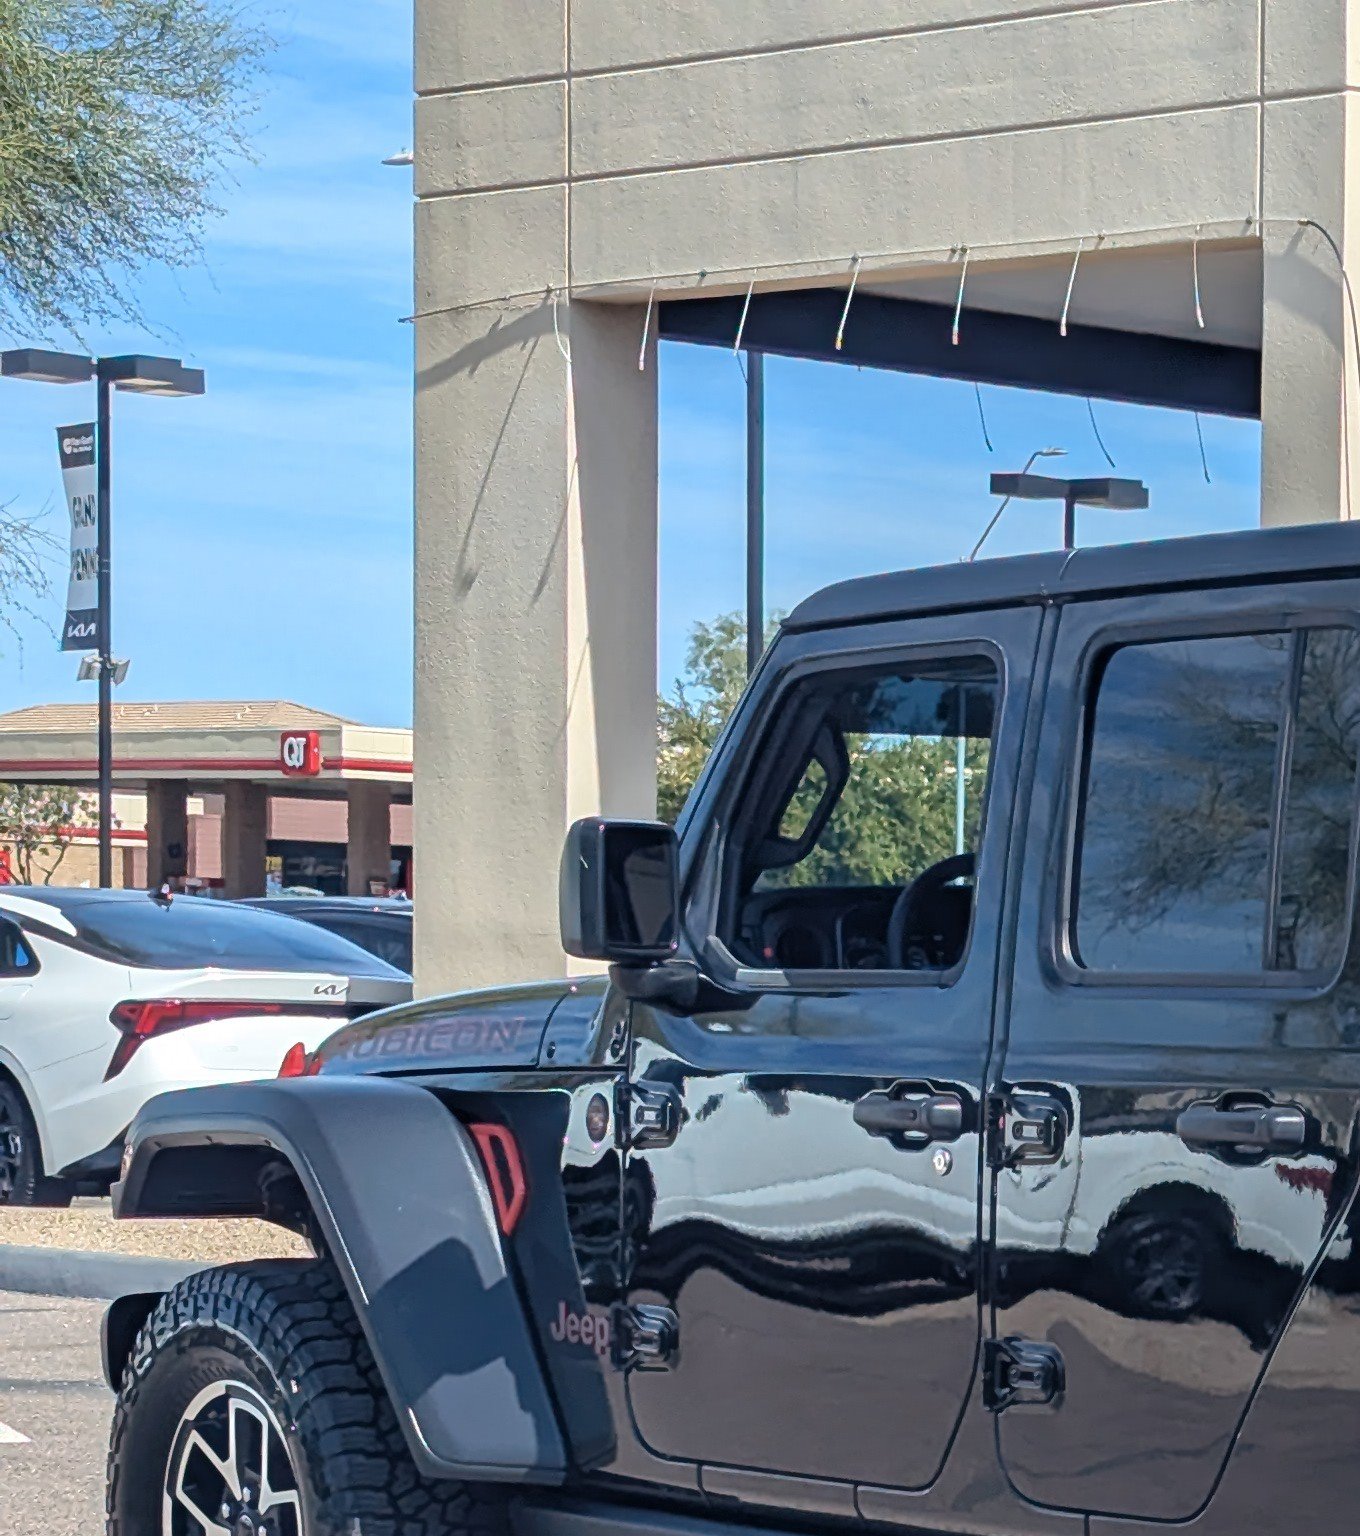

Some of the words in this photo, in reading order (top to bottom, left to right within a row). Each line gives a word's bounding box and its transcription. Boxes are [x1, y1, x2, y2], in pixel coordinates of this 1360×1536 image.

[283, 736, 307, 769] QT
[341, 1017, 524, 1060] UBICON
[550, 1300, 610, 1356] Jeep
